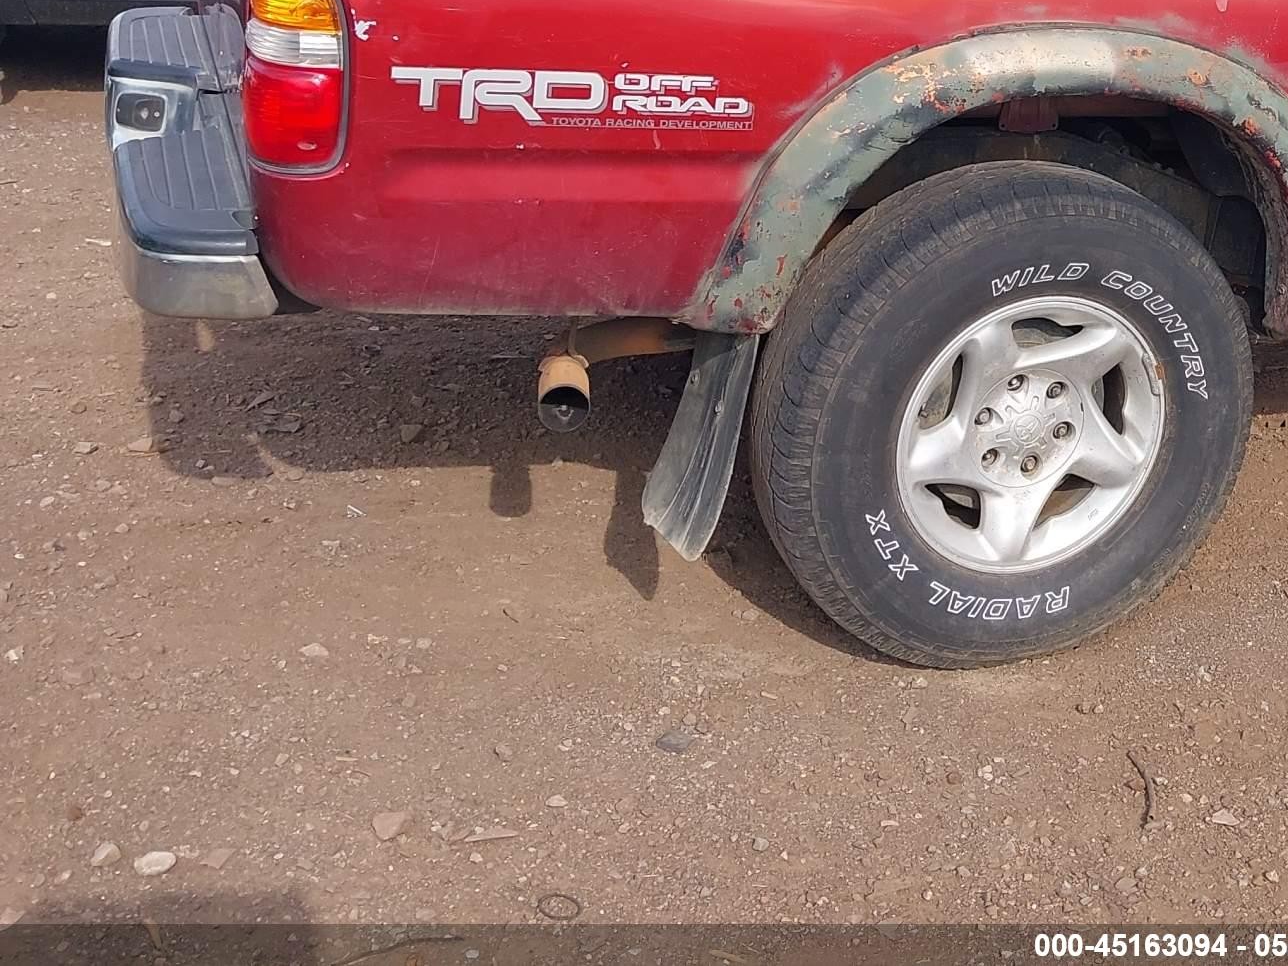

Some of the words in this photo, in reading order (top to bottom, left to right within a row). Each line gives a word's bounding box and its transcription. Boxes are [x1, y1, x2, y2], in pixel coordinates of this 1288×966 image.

[391, 66, 607, 124] TRD
[613, 72, 717, 94] OFF
[551, 116, 601, 128] TOYOTA
[605, 117, 655, 129] RACING
[659, 119, 751, 131] DEVELOPMENT
[612, 94, 754, 116] ROAD
[991, 262, 1090, 296] WILD
[1101, 270, 1208, 399] COUNTRY
[865, 509, 919, 581] XTX
[929, 581, 1071, 620] RADIAL
